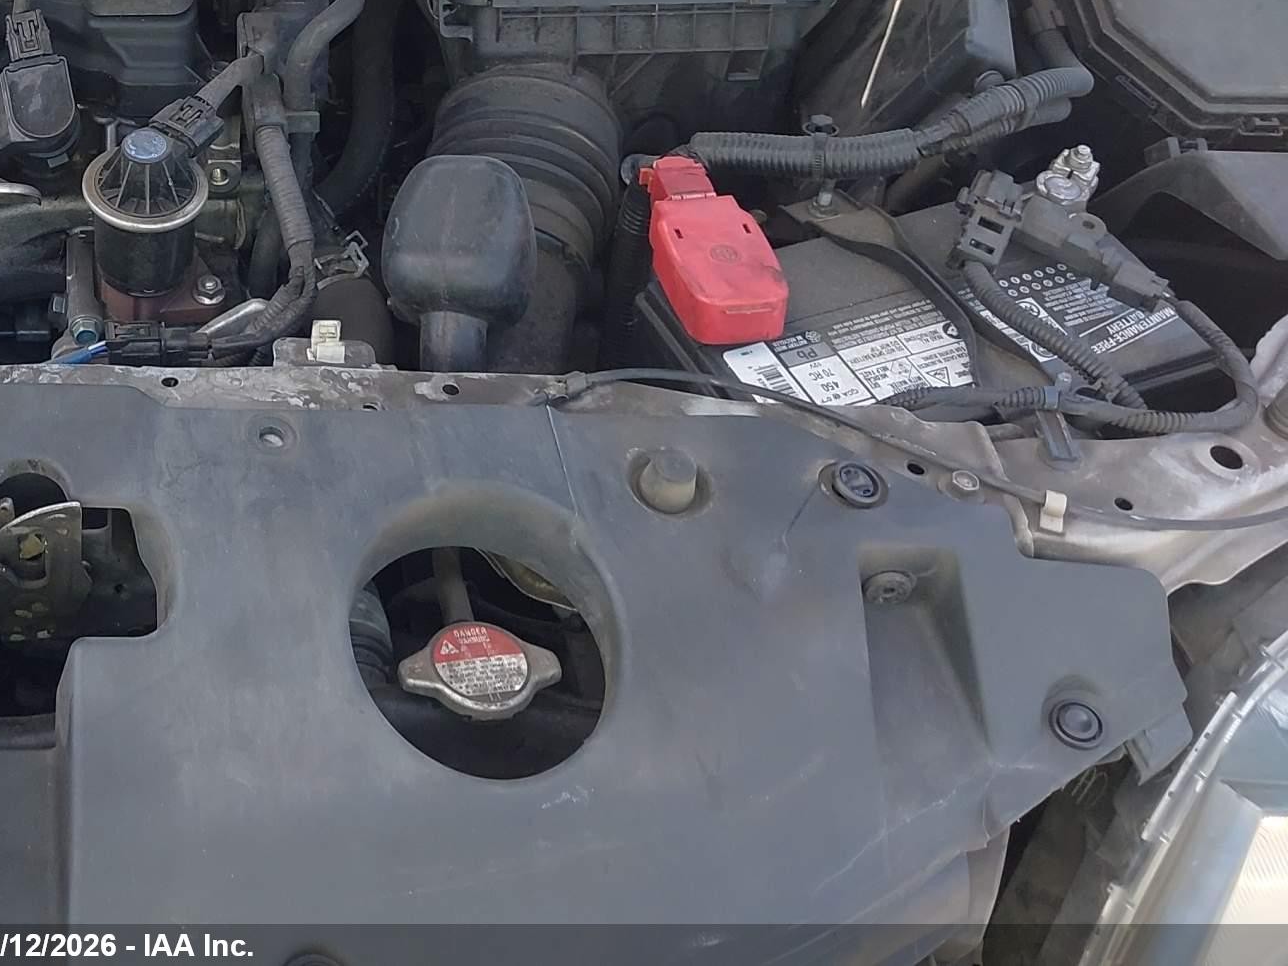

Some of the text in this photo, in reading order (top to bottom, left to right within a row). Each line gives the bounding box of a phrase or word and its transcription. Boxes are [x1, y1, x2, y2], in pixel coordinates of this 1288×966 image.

[1090, 306, 1176, 355] MAINTENANCE-FREE
[796, 347, 818, 360] Pb
[808, 368, 835, 381] 70 RC
[820, 380, 840, 392] 450
[453, 626, 488, 637] DANGER
